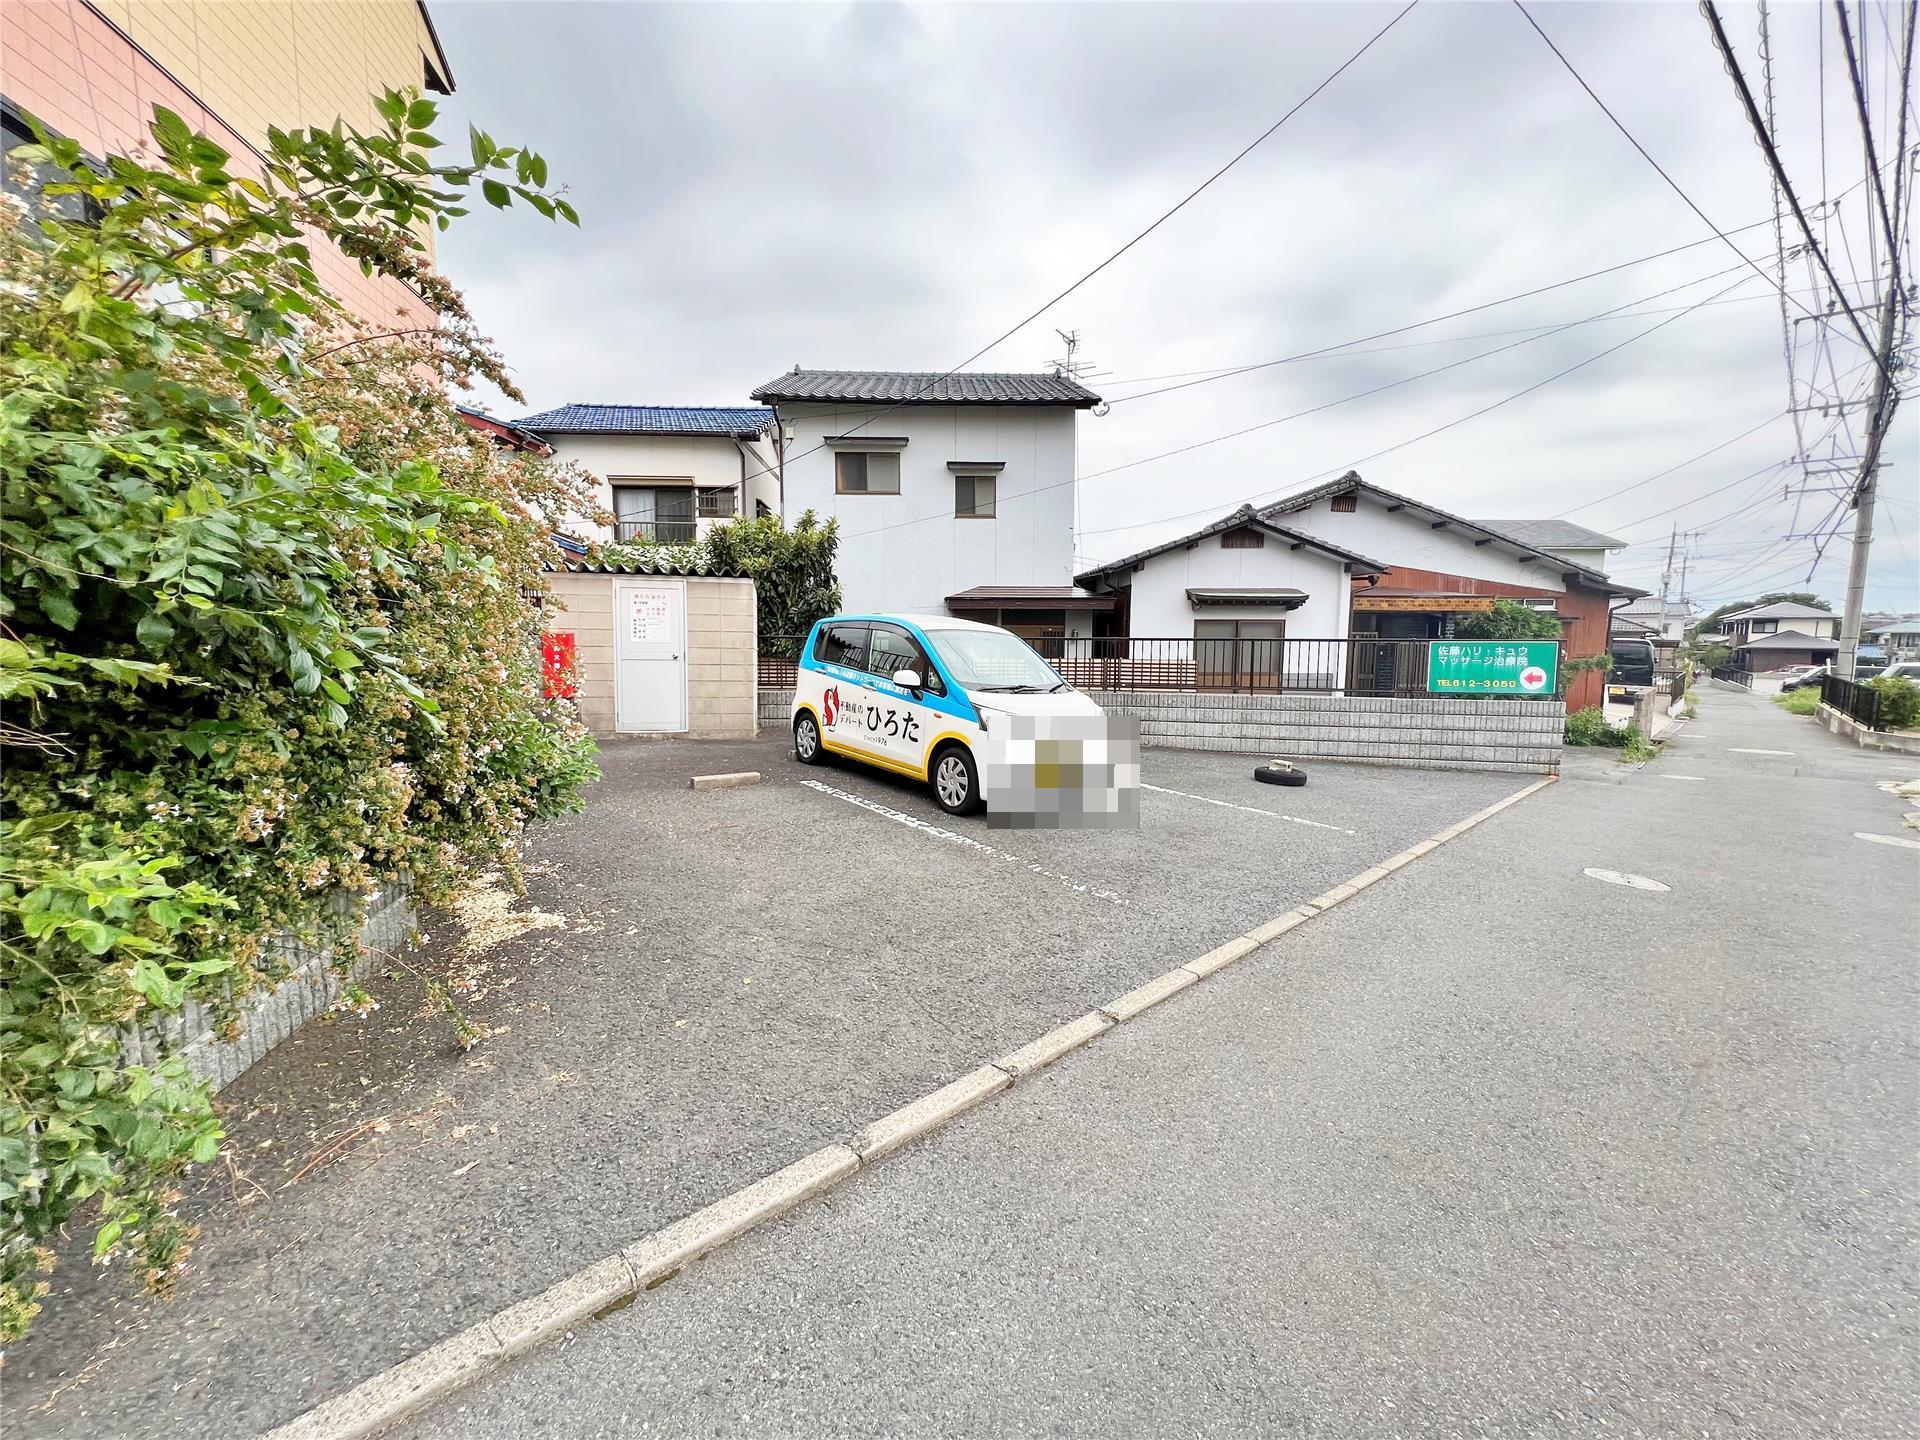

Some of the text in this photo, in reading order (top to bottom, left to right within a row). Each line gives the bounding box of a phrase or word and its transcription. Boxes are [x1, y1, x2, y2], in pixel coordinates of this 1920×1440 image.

[1438, 645, 1528, 656] 佐藤ハリ・キュウ
[1438, 656, 1528, 666] マッサージ治療院
[840, 701, 864, 715] 不動産の
[840, 713, 863, 728] デパート
[866, 706, 919, 743] ひろた
